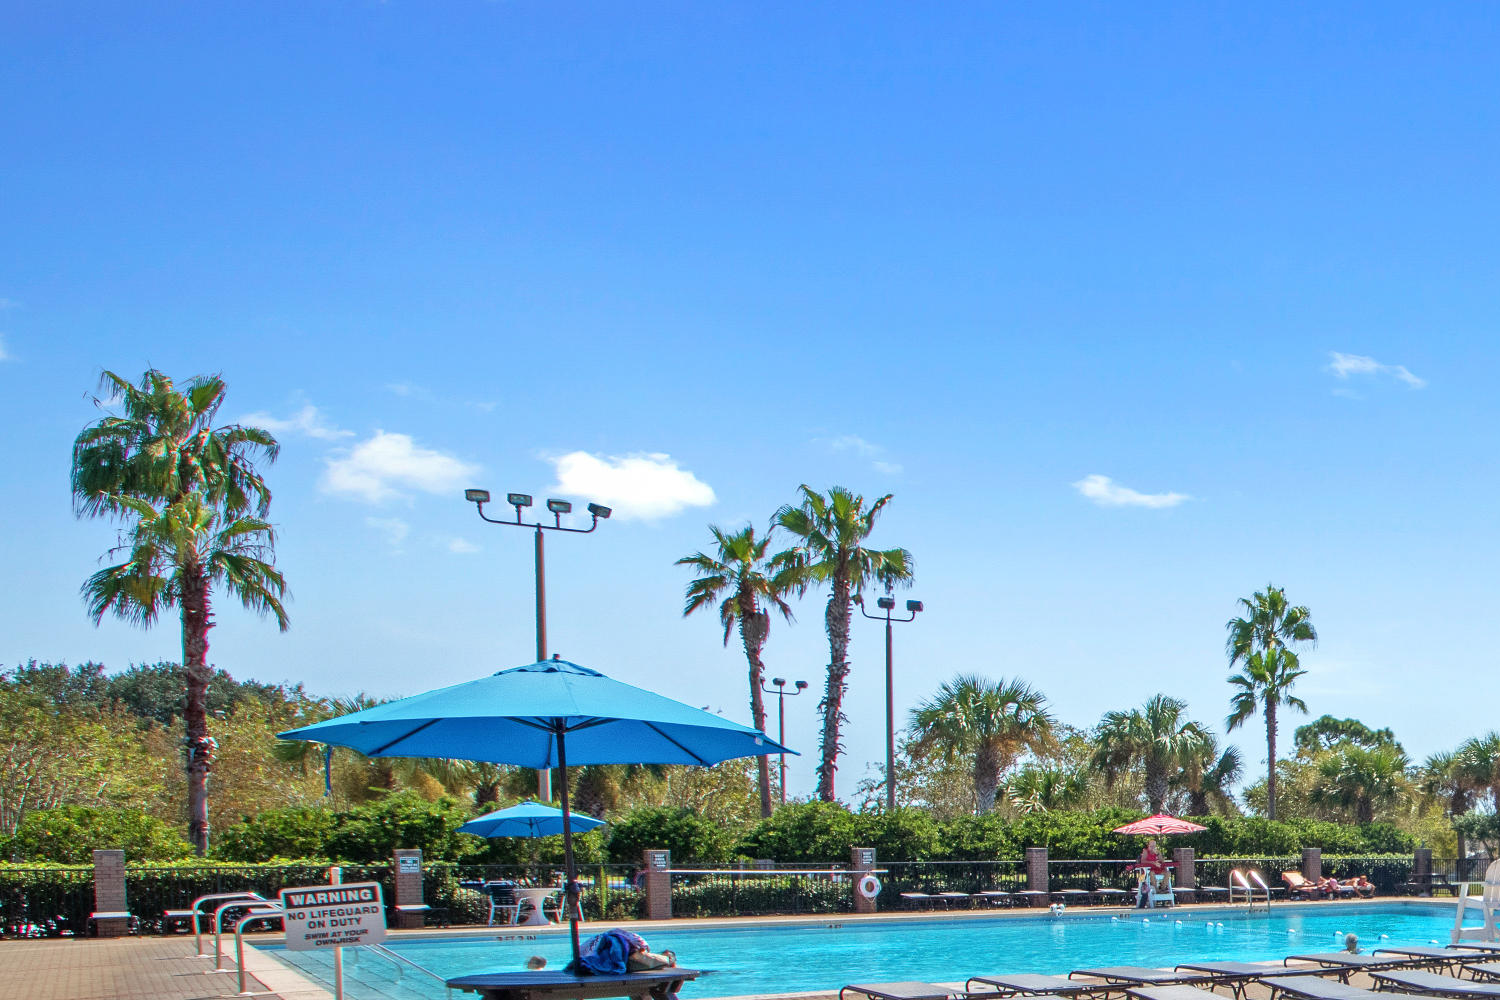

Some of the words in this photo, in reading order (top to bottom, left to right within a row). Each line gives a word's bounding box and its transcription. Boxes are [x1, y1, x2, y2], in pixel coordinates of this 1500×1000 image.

[289, 889, 373, 906] WARNING
[288, 911, 306, 920] NO
[310, 905, 379, 919] LIFEGUARD
[308, 920, 326, 929] ON
[330, 917, 361, 927] DUTY
[304, 932, 329, 940] SWIM
[340, 936, 361, 944] RISK
